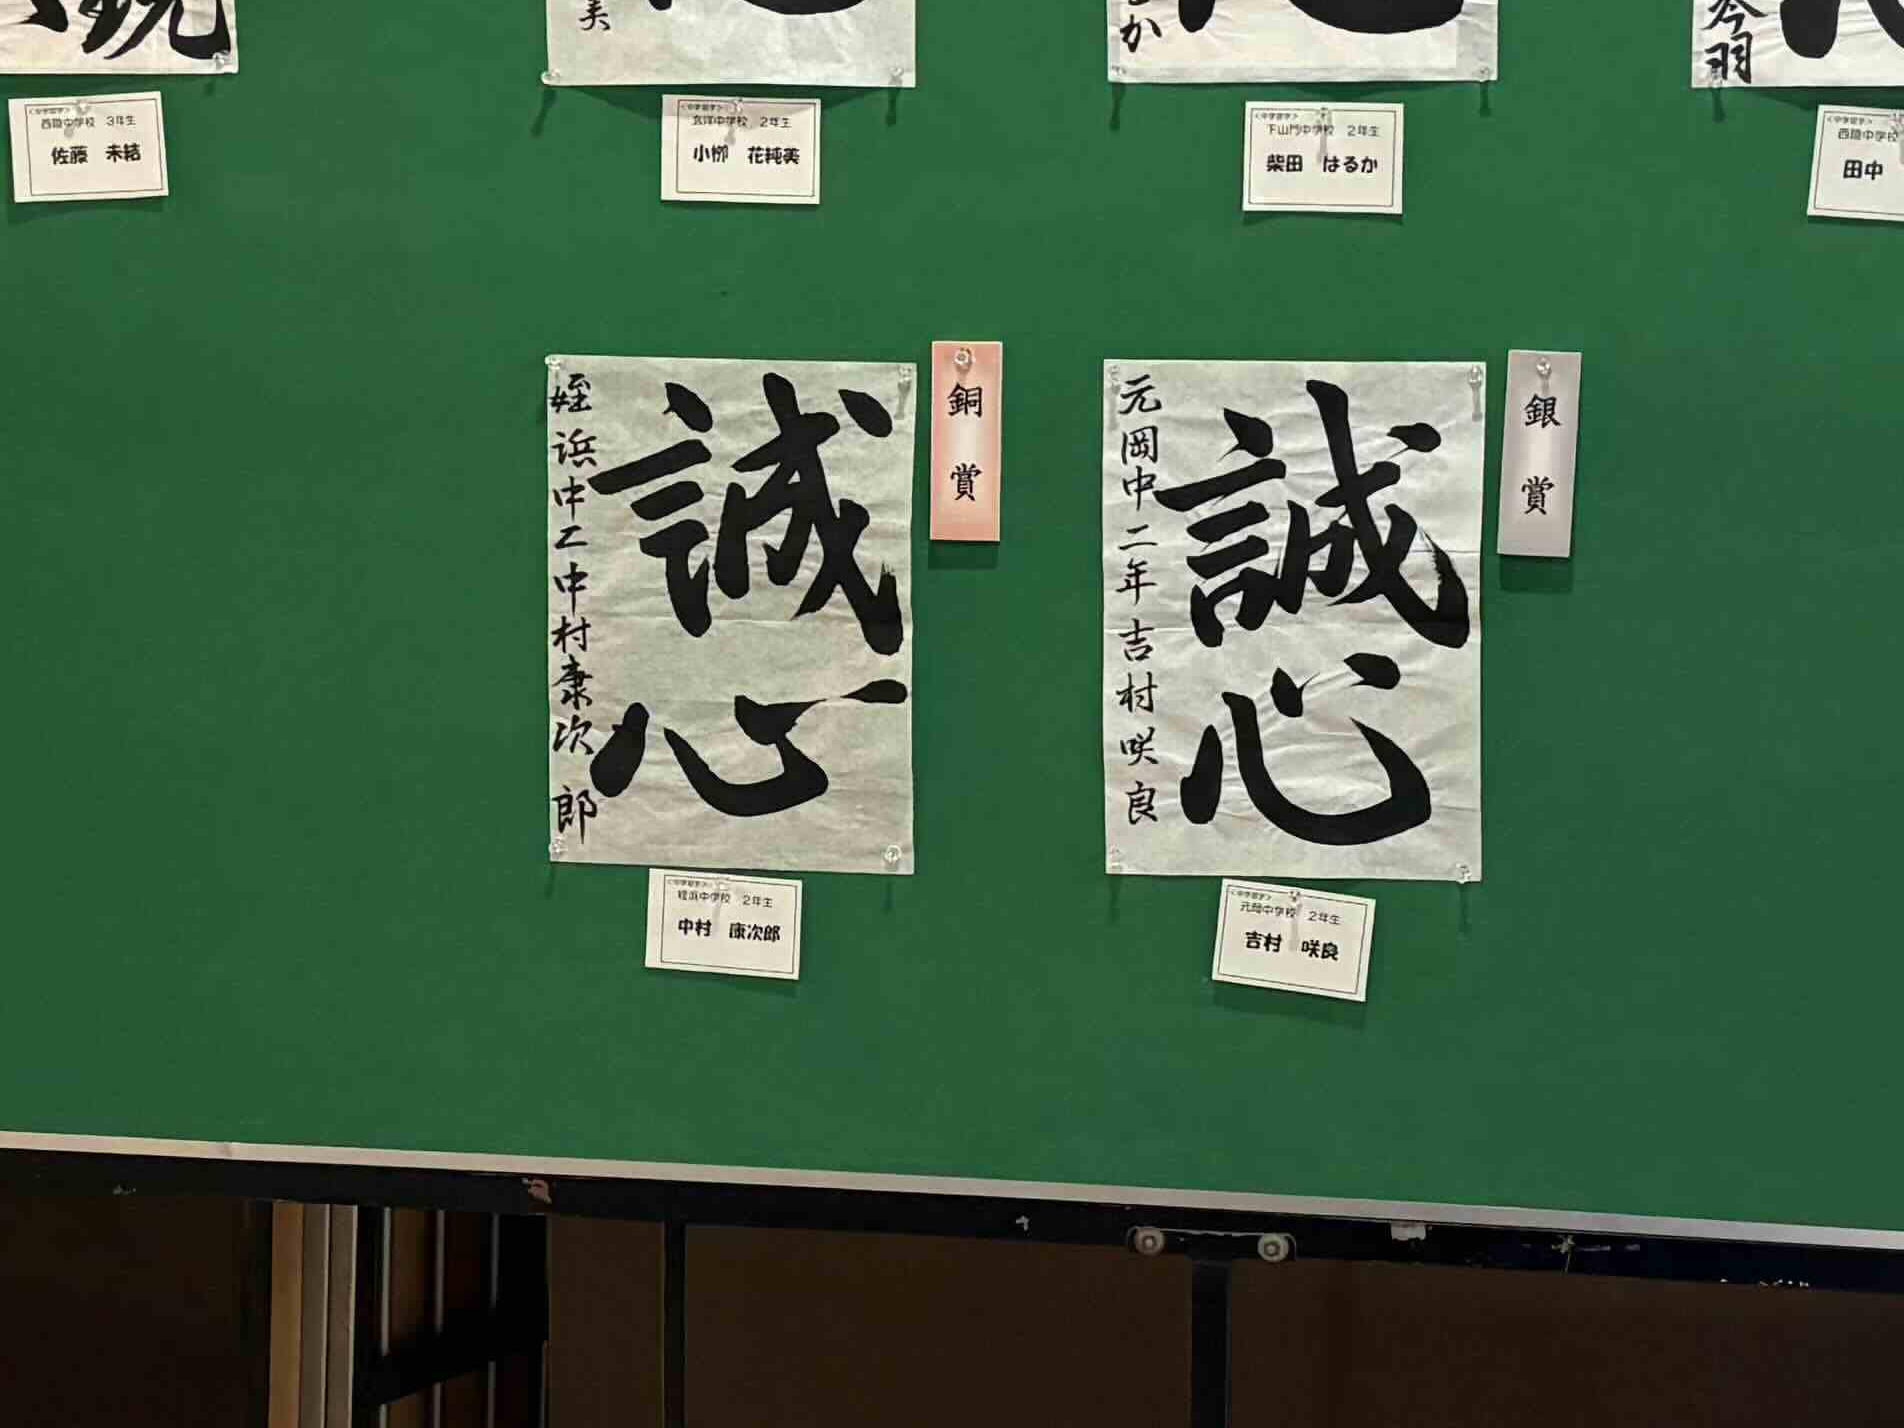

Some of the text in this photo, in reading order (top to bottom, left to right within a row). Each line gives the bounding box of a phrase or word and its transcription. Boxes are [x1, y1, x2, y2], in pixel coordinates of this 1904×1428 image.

[52, 144, 141, 165] 佐藤 未結
[1266, 155, 1378, 173] 柴田 はるか
[1844, 160, 1883, 180] 田中
[947, 383, 983, 501] 銅賞
[1521, 393, 1561, 515] 銀賞
[587, 371, 908, 818] 誠心
[1154, 379, 1470, 846] 誠心
[678, 918, 781, 943] 中村 康次郎
[1245, 931, 1339, 961] 吉村 咲良
